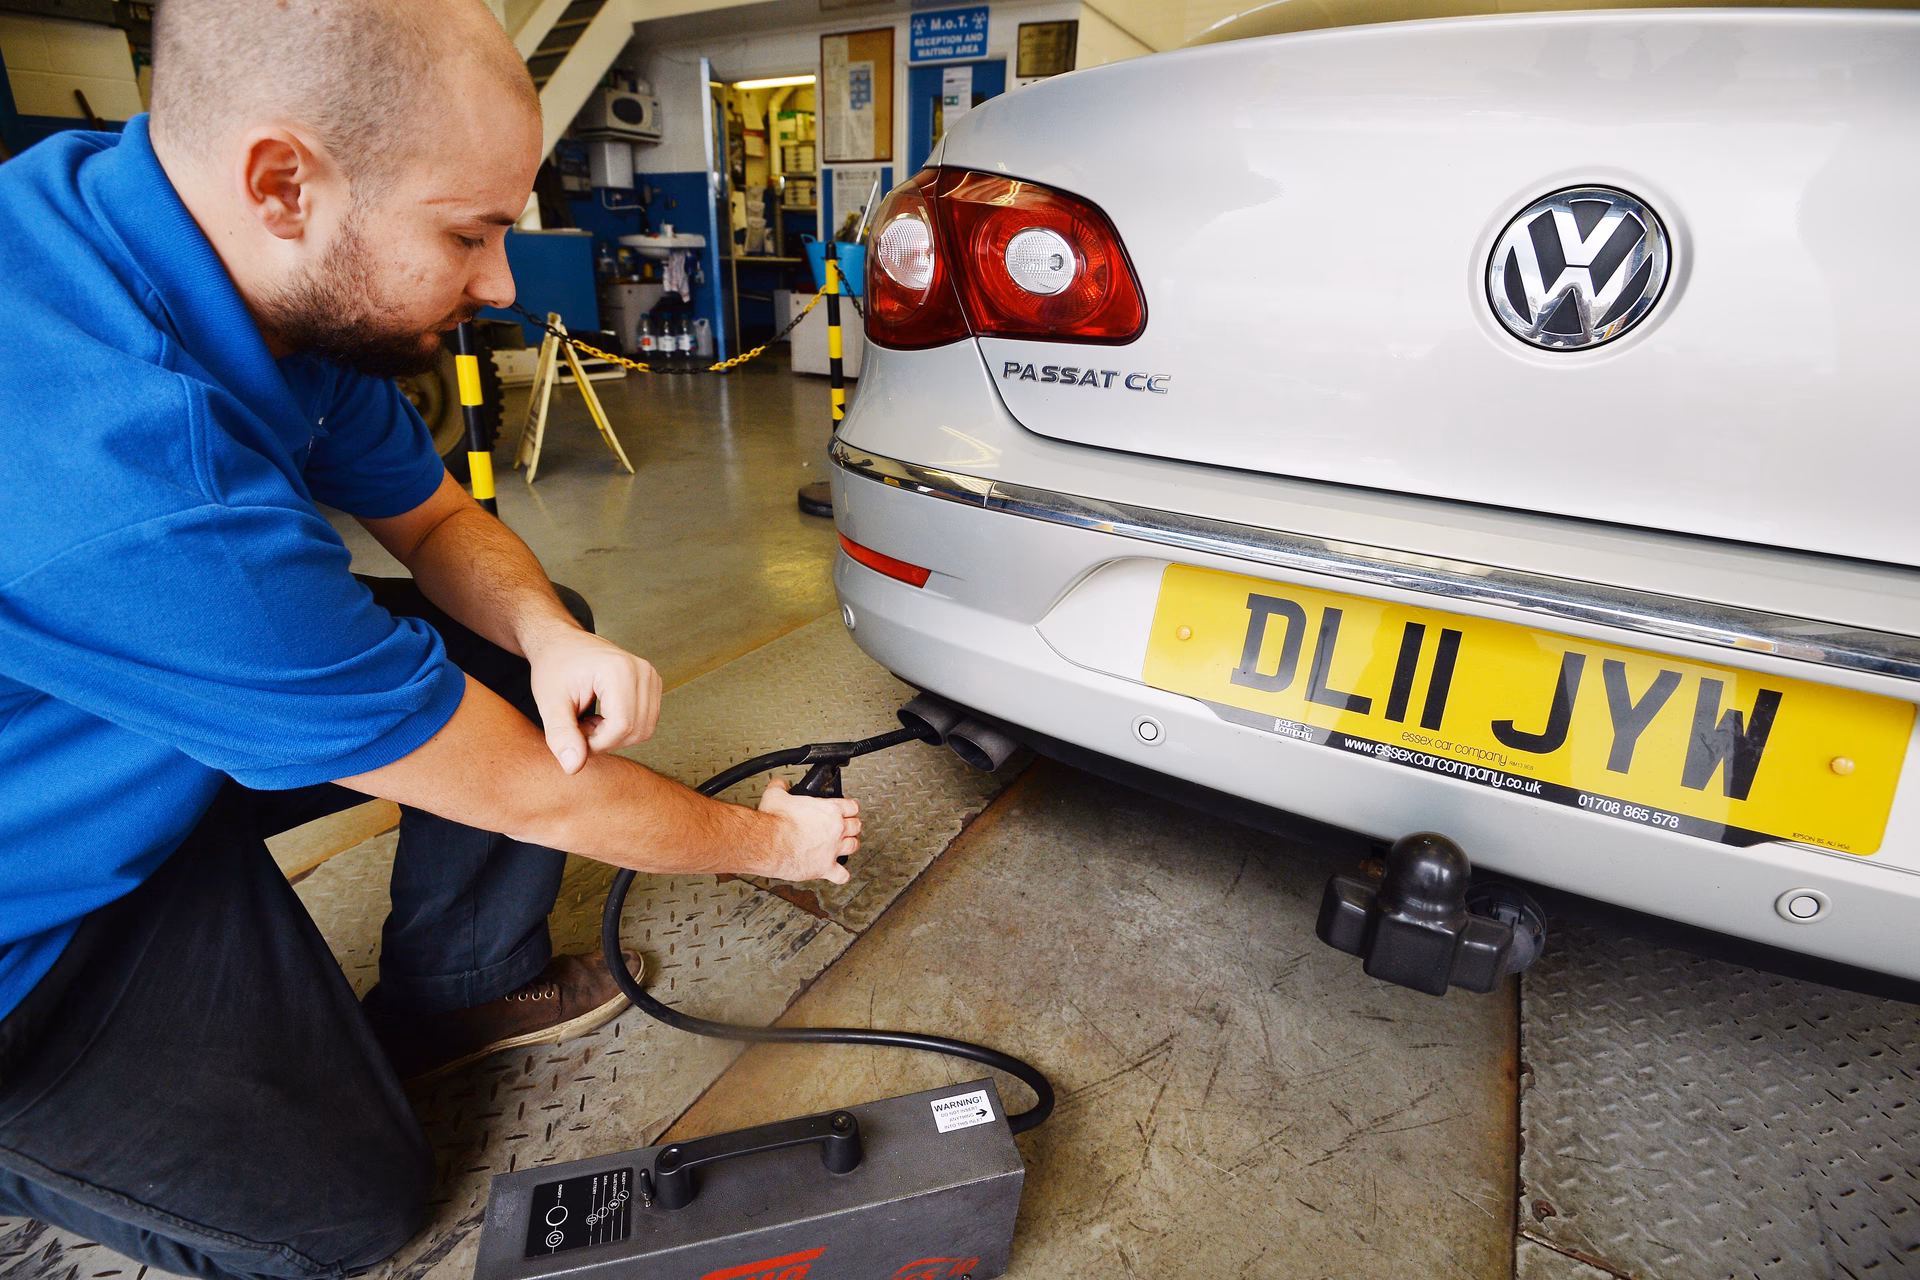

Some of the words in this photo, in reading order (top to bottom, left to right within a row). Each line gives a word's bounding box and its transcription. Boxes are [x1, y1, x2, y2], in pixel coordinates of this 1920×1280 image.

[930, 15, 968, 31] M.o.T.
[914, 34, 962, 47] RECEPTION
[964, 32, 983, 42] AND
[918, 47, 953, 57] WAITING
[955, 44, 979, 54] AREA
[1002, 361, 1121, 389] PASSAT
[1124, 372, 1172, 394] CC
[1230, 593, 1462, 731] DL11
[1491, 651, 1783, 801] JYW
[1279, 726, 1313, 741] company
[1401, 731, 1434, 746] essex
[1434, 739, 1454, 751] car
[1455, 743, 1508, 766] company
[1344, 738, 1542, 794] www.essexcarcompany.co.uk
[1578, 794, 1620, 814] 01708
[1623, 805, 1650, 822] 865
[1652, 811, 1679, 829] 578
[934, 1096, 983, 1112] WARNING!
